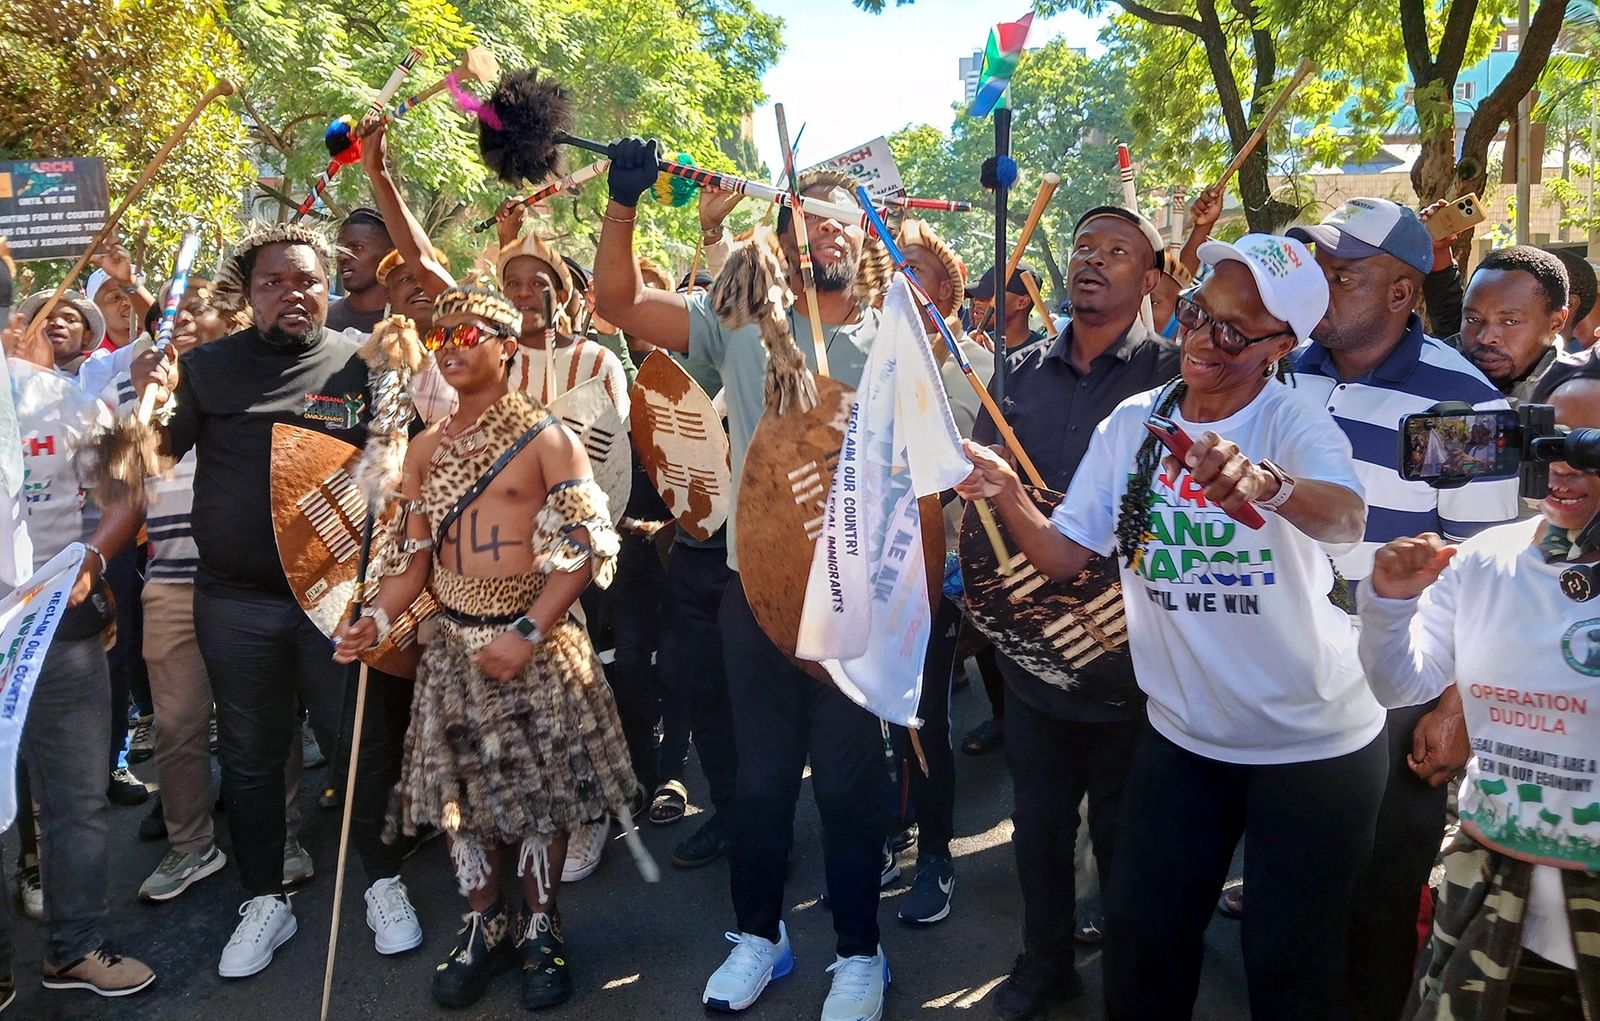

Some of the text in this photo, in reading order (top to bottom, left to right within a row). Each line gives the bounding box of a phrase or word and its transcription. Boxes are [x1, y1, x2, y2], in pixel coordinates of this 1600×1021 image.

[828, 146, 873, 167] ARCH
[844, 466, 856, 492] OUR
[844, 497, 859, 556] COUNTRY
[1149, 511, 1236, 547] AND
[827, 535, 844, 613] IMMIGRANTS
[32, 591, 63, 637] RECLAIM
[1186, 592, 1217, 612] WE
[1223, 593, 1260, 615] WIN
[21, 641, 40, 660] OUR
[1470, 683, 1588, 715] OPERATION
[1489, 706, 1567, 736] DUDULA
[1495, 741, 1558, 768] IMMIGRANTS
[1511, 765, 1534, 783] OUR
